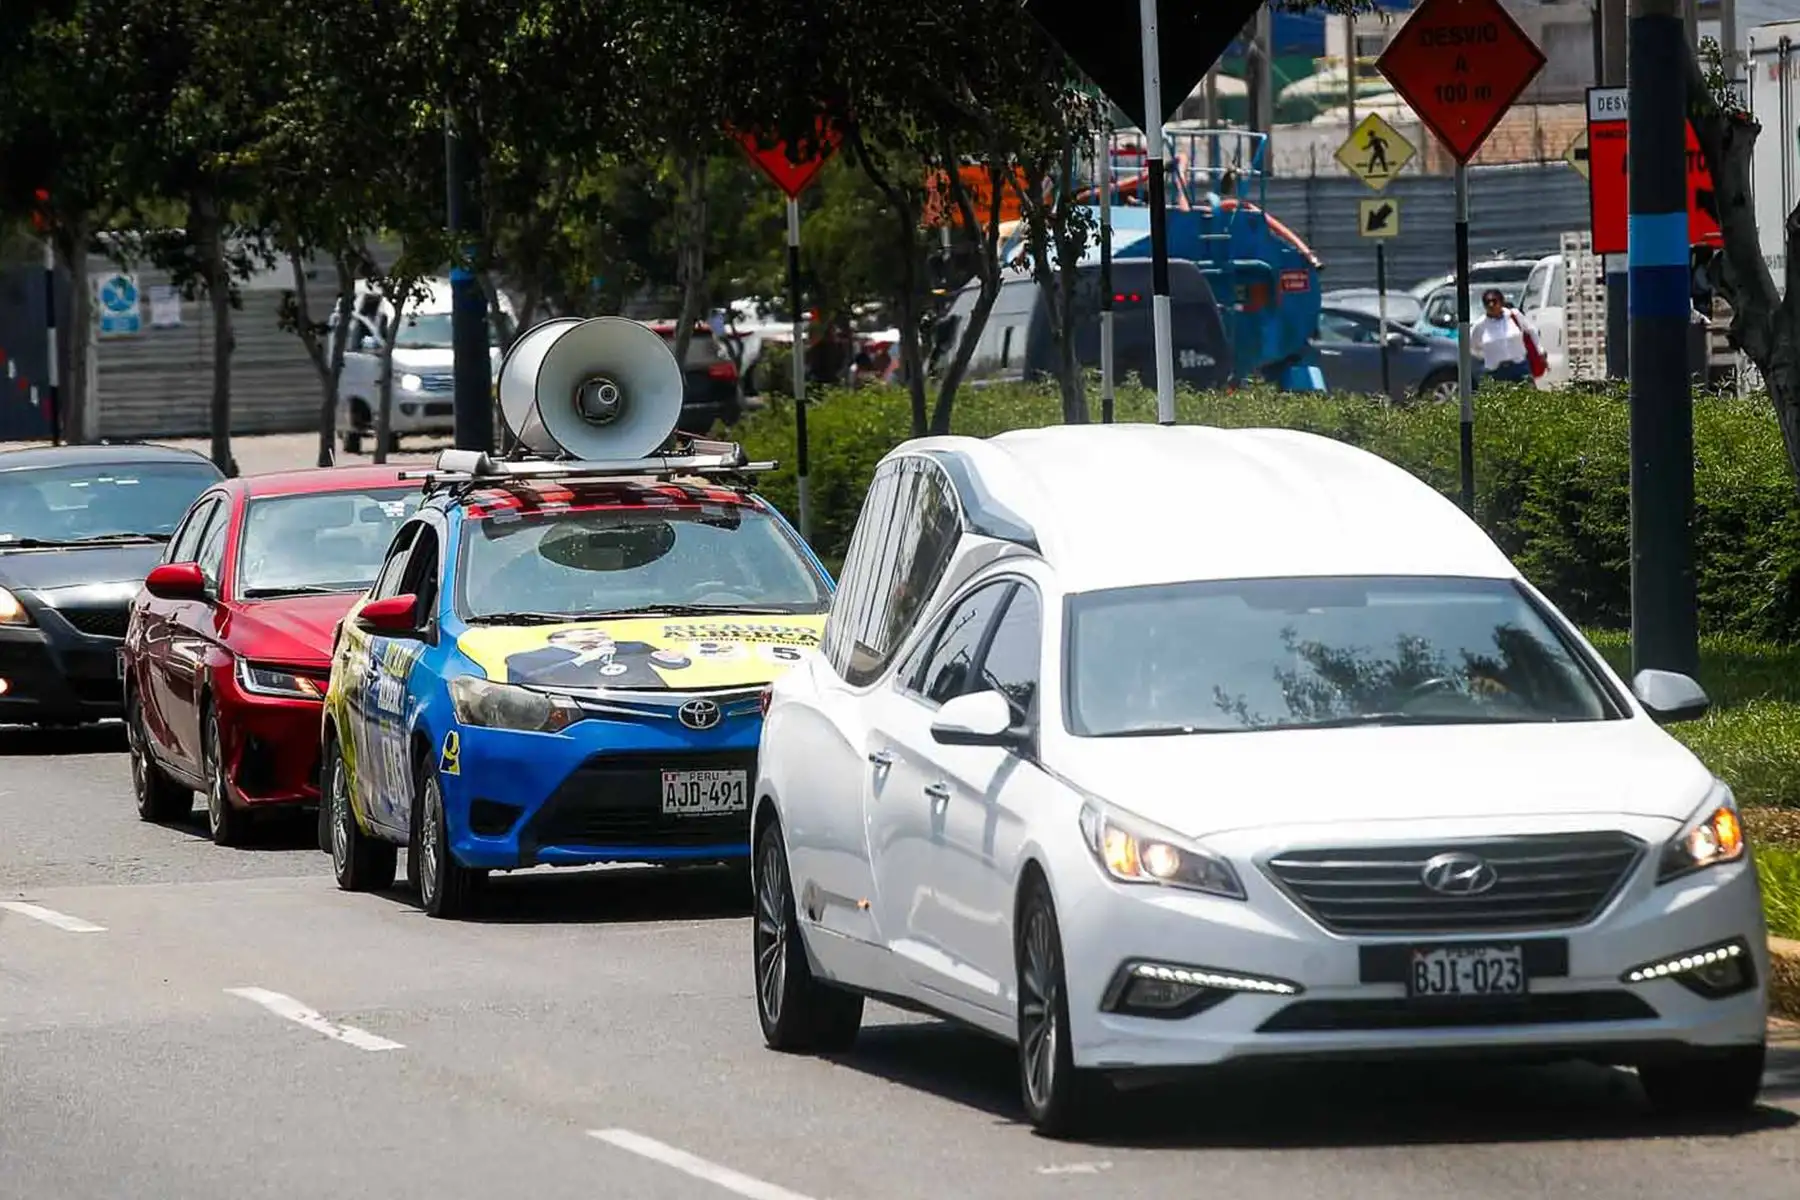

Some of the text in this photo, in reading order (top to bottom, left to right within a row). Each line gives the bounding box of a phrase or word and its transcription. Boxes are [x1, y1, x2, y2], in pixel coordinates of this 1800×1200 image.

[1419, 21, 1499, 47] DESVIO
[1455, 53, 1470, 74] A
[1433, 82, 1492, 105] 100 m
[1597, 96, 1628, 112] DESV
[773, 646, 802, 661] 5
[689, 772, 720, 781] PERU
[665, 781, 744, 807] AJD-491
[1415, 958, 1521, 993] BJI-023
